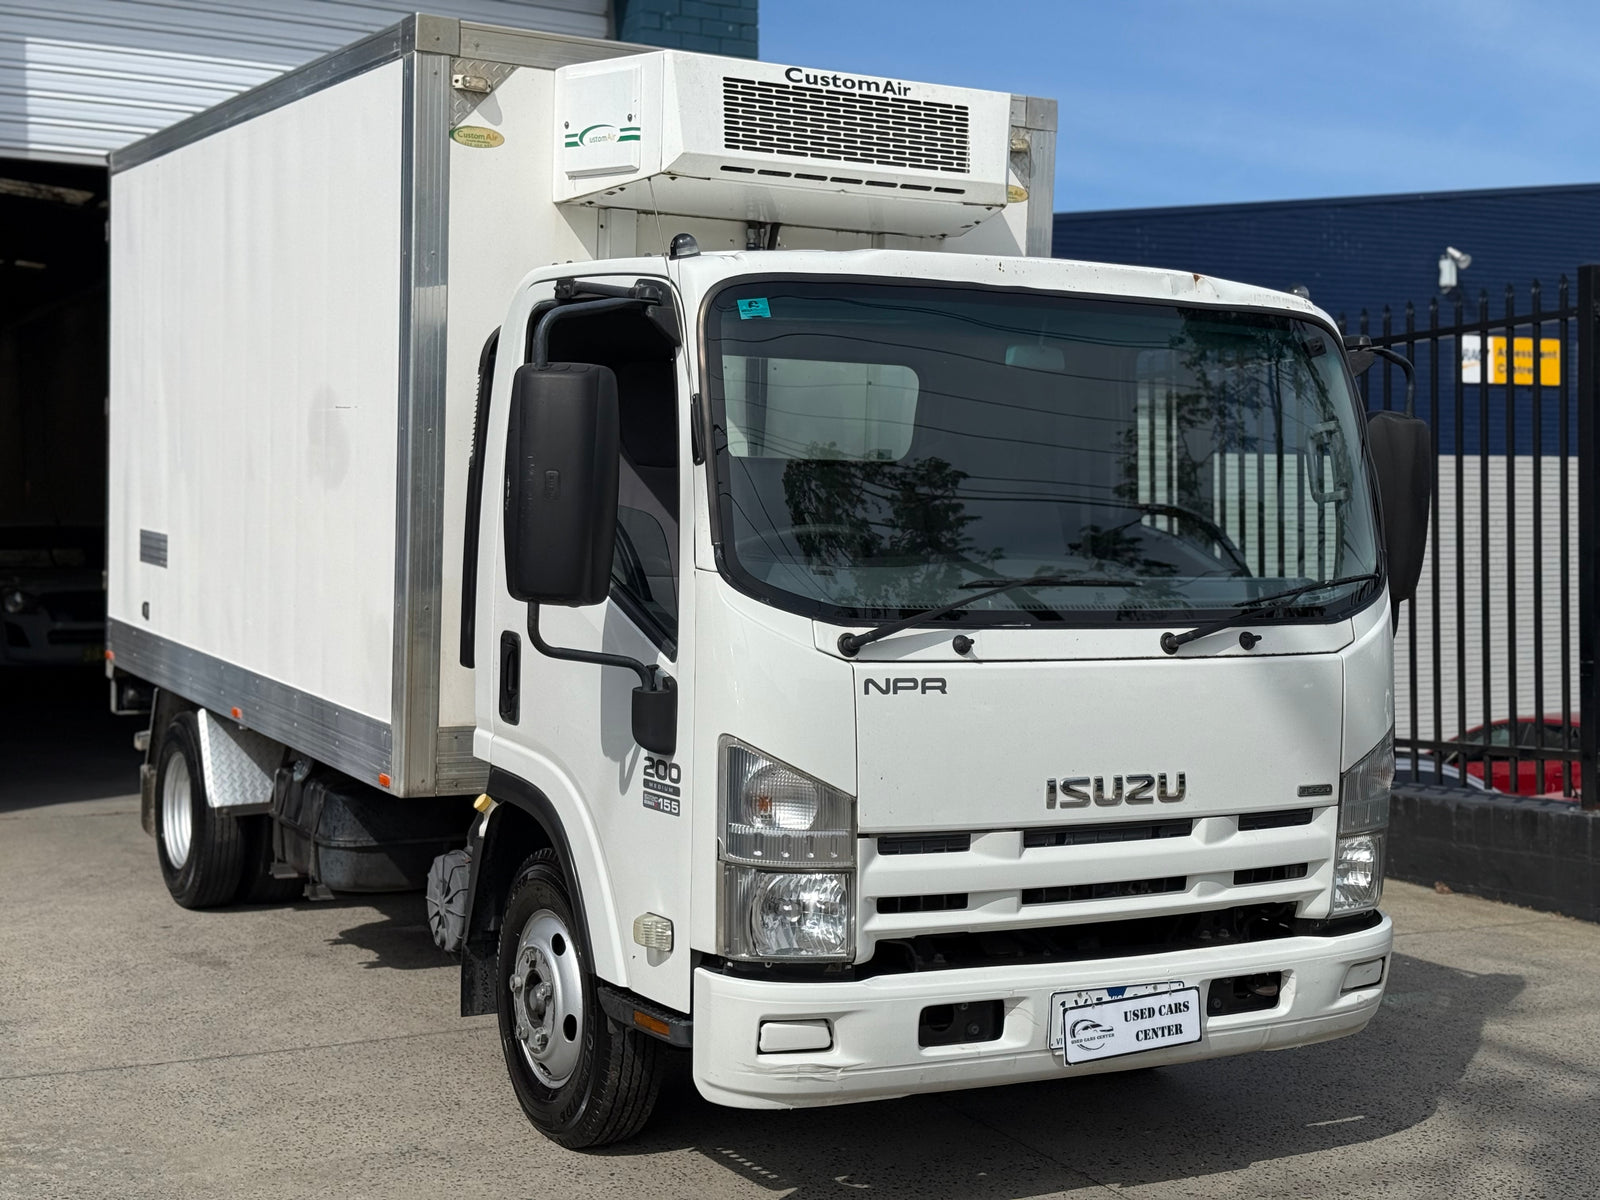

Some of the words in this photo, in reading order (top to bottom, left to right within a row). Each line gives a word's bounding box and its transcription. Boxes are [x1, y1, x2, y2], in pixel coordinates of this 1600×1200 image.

[863, 677, 948, 695] NPR
[643, 756, 682, 785] 200
[1046, 771, 1186, 810] ISUZU
[658, 798, 679, 813] 155
[1123, 1007, 1155, 1023] USED
[1158, 1000, 1190, 1016] CARS
[1135, 1023, 1184, 1042] CENTER
